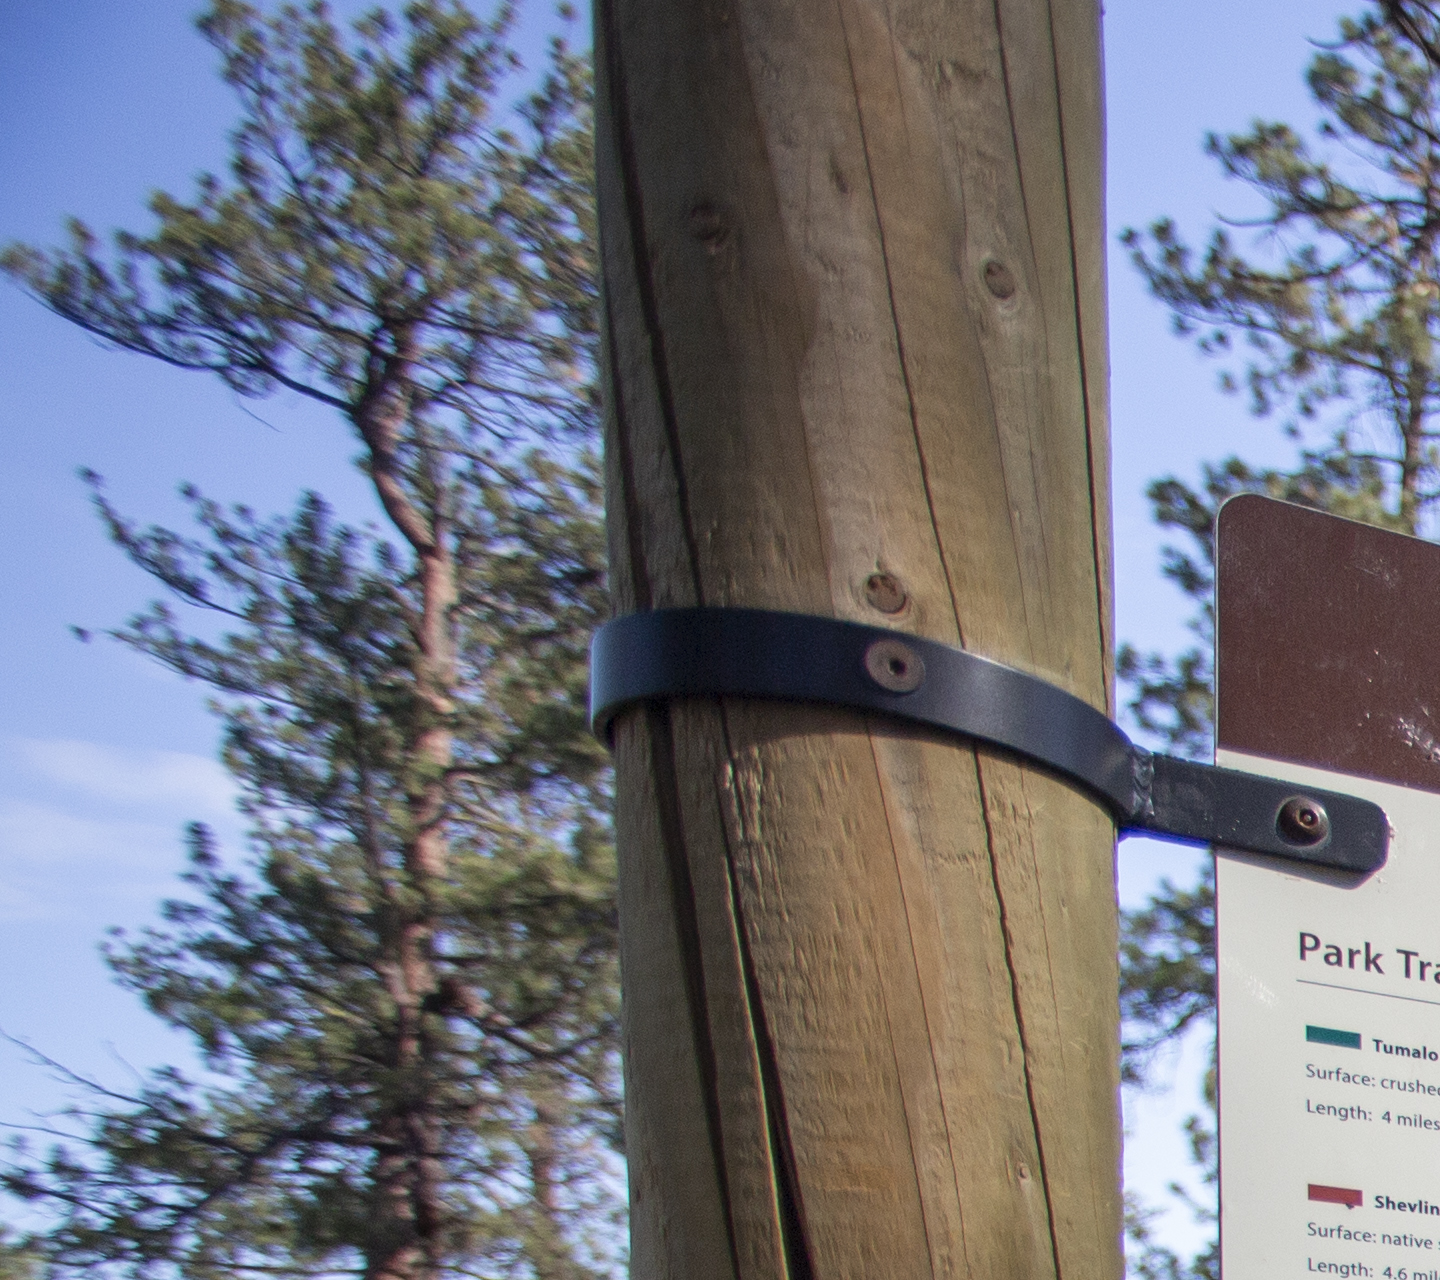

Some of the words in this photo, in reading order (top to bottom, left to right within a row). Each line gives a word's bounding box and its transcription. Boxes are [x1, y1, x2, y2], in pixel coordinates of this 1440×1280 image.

[1300, 932, 1383, 973] Park
[1373, 1039, 1438, 1061] Tumalo
[1306, 1064, 1376, 1085] Surface:
[1307, 1100, 1372, 1121] Length:
[1382, 1111, 1390, 1122] 4
[1397, 1115, 1440, 1130] miles
[1375, 1196, 1439, 1215] Shevlin
[1308, 1222, 1377, 1242] Surface:
[1382, 1234, 1432, 1249] native
[1308, 1258, 1373, 1278] Length:
[1383, 1267, 1407, 1280] 4.6
